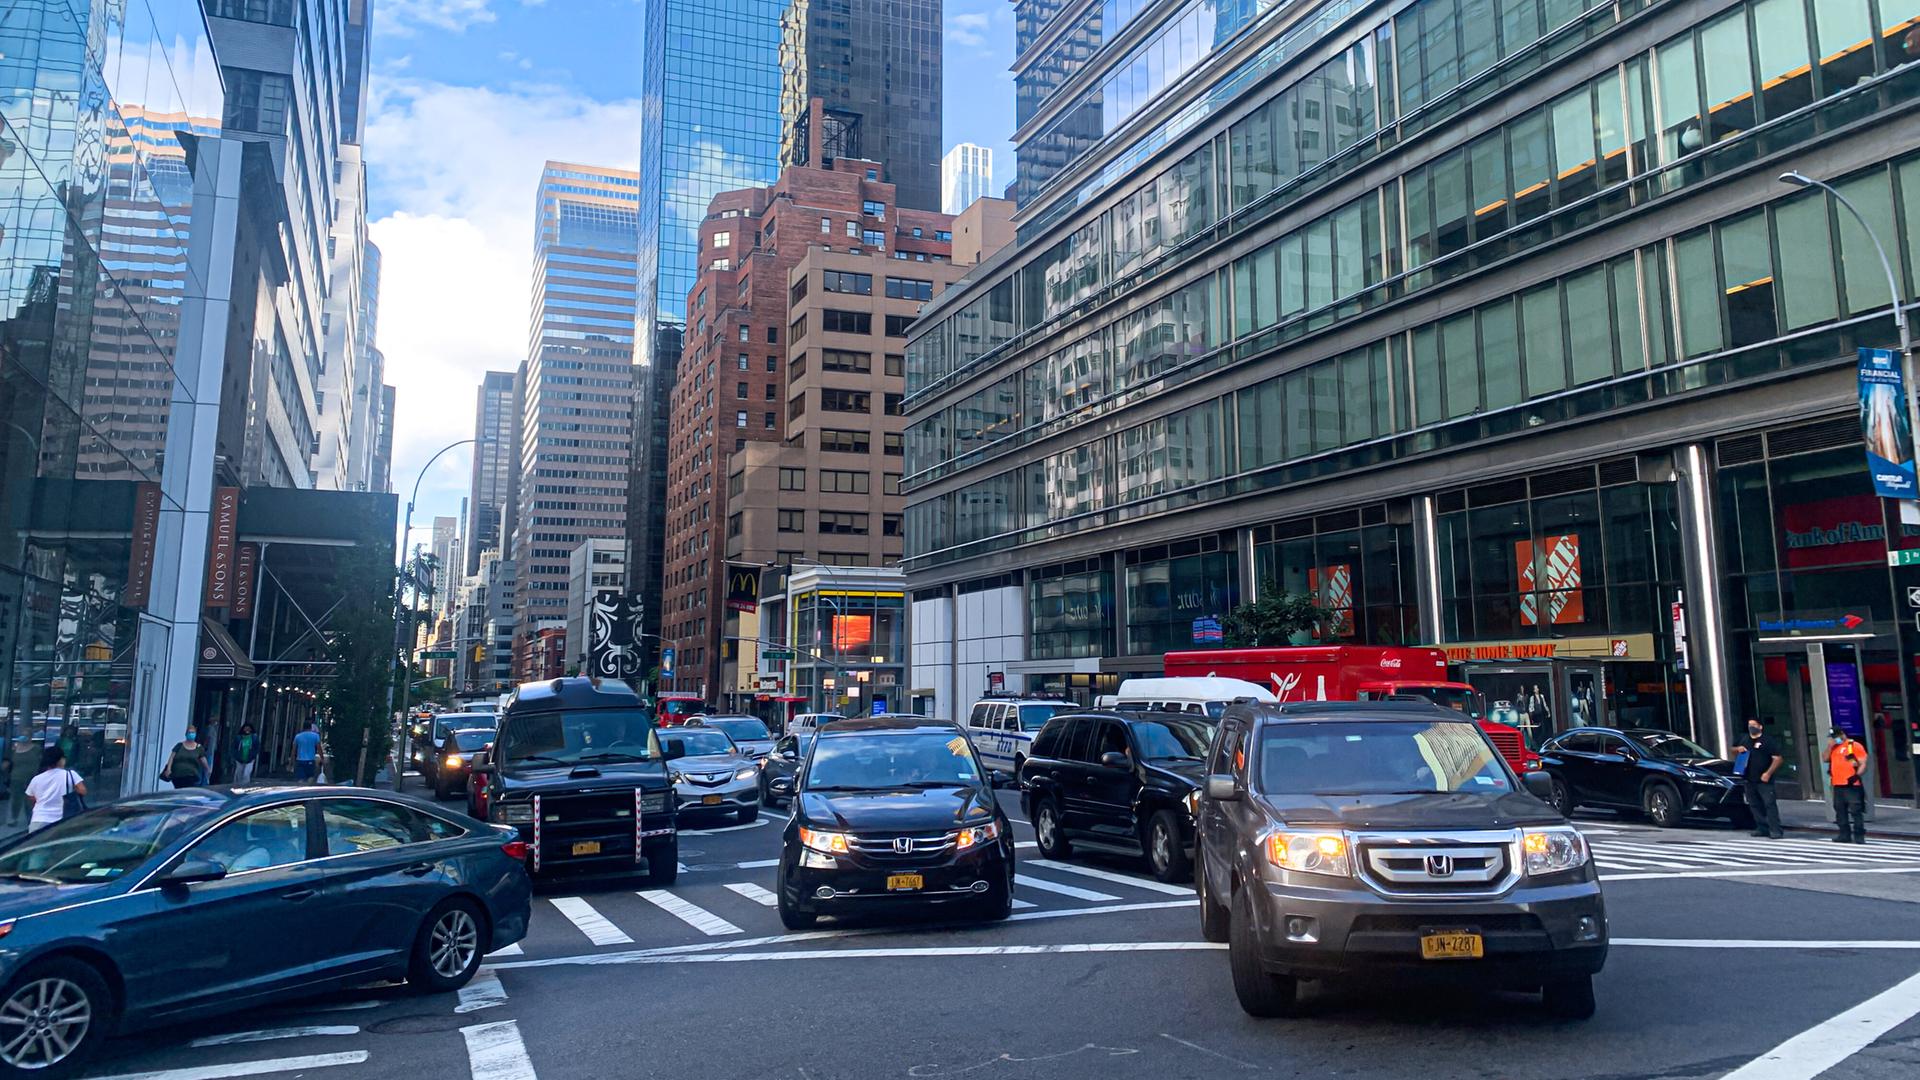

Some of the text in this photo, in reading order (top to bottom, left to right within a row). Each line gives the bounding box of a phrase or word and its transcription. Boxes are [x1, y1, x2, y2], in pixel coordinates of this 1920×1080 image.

[1861, 369, 1900, 378] FINANCIAL
[216, 494, 233, 549] SAMUEL
[1826, 522, 1846, 545] of
[212, 562, 227, 600] SONS
[236, 578, 248, 613] SONS
